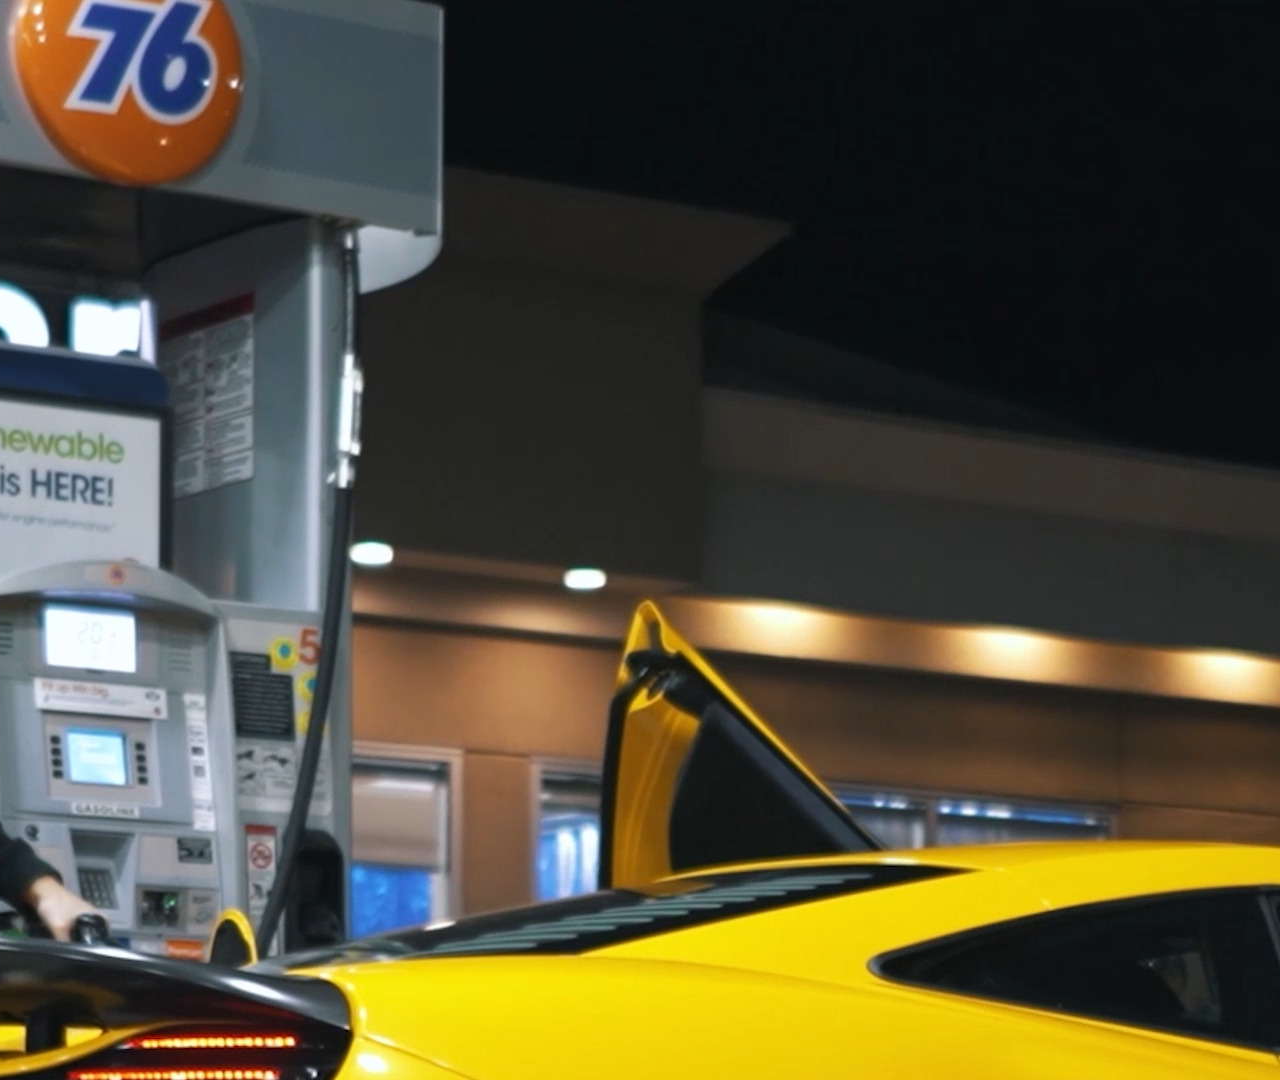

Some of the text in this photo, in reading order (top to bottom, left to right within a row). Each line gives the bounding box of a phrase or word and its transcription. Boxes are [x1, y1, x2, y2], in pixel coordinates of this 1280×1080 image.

[63, 0, 219, 126] 76
[0, 465, 22, 497] is
[30, 469, 114, 507] HERE!
[75, 802, 136, 817] GASOLINE
